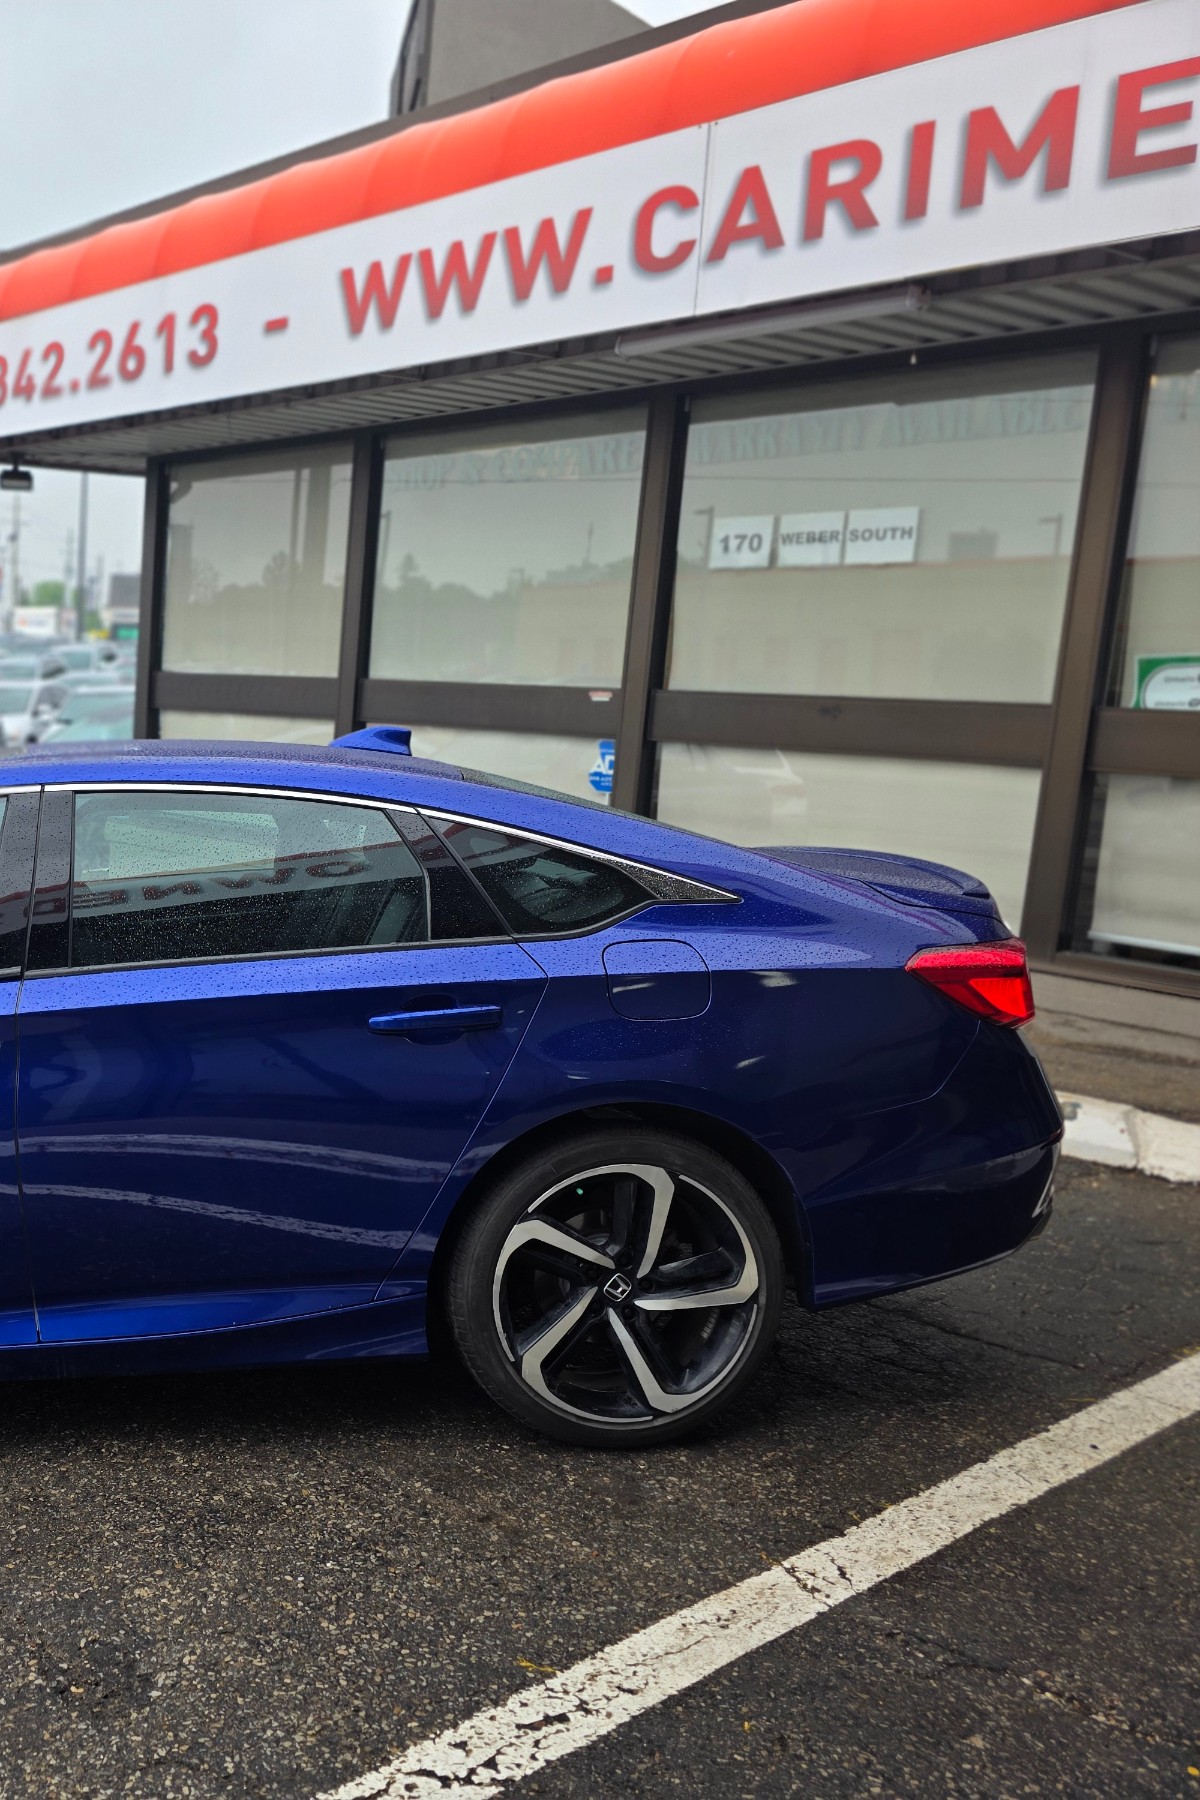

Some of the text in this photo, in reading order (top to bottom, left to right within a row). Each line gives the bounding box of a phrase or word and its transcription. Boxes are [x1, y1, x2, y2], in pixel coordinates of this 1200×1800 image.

[719, 526, 914, 554] 170 WEBER SOUTH
